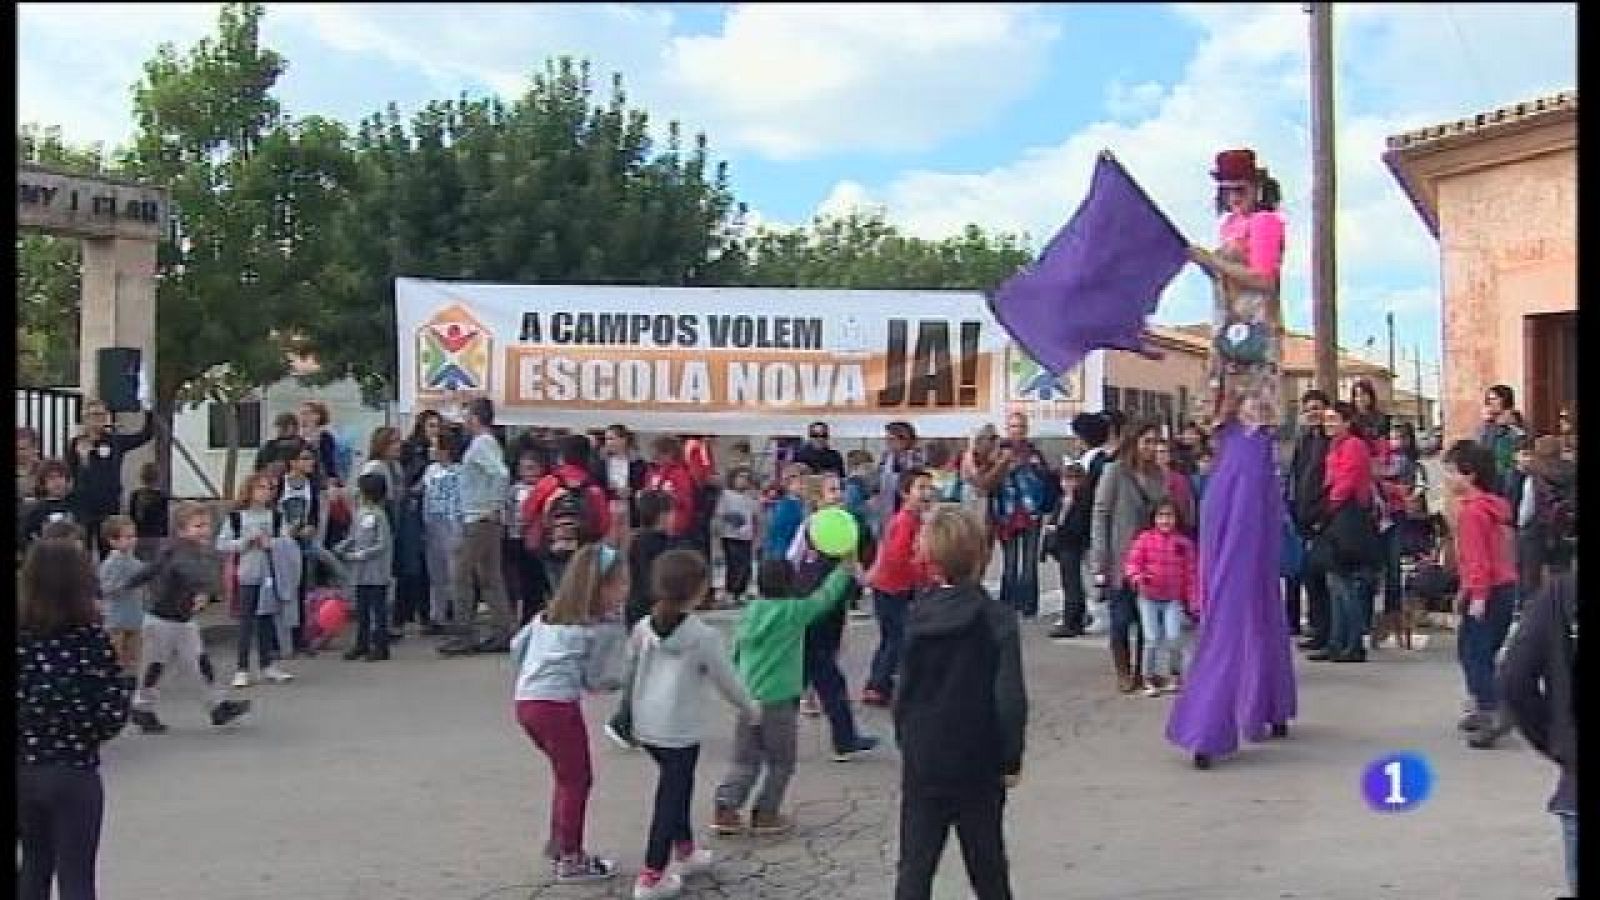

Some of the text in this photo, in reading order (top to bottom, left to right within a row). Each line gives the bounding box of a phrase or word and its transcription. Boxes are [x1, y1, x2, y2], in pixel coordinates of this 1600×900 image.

[520, 312, 824, 349] A CAMPOS VOLEM
[519, 355, 865, 405] ESCOLA NOVA
[878, 319, 981, 407] JA!
